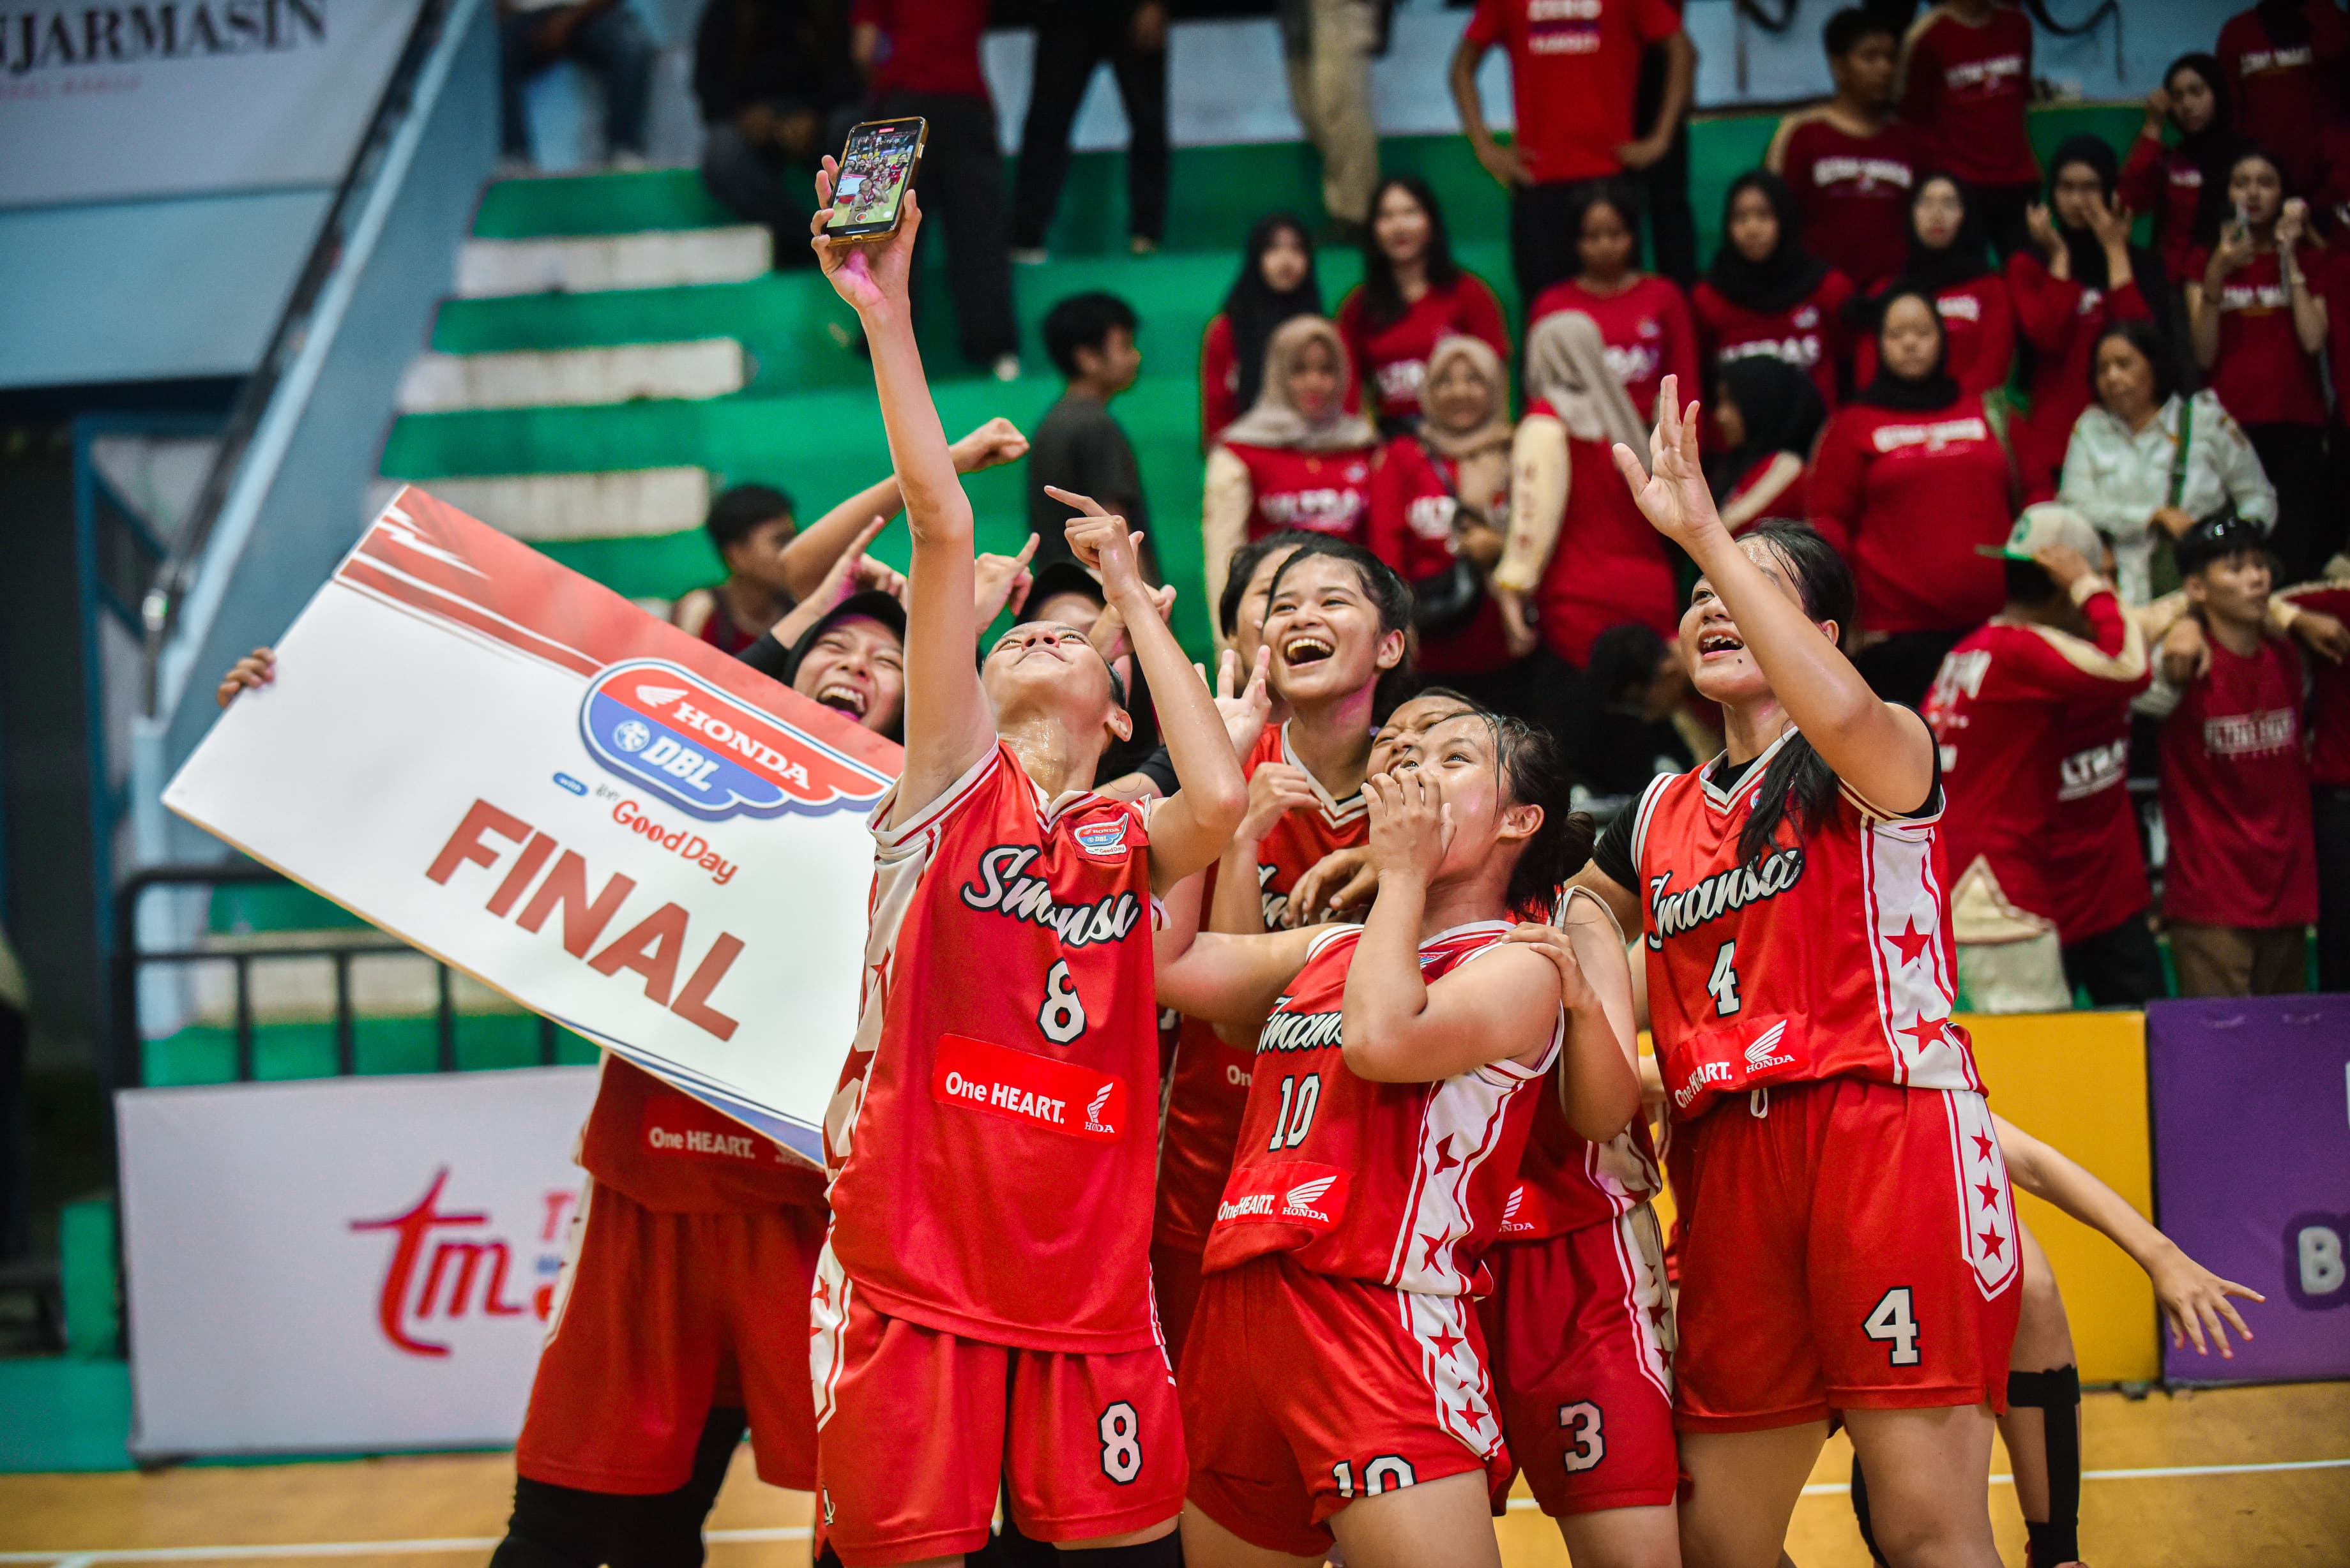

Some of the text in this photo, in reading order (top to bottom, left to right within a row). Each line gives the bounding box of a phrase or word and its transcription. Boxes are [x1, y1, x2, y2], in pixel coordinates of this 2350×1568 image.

[0, 0, 326, 78] JARMASIN
[639, 735, 720, 792] DBL
[672, 701, 810, 790] HONDA
[425, 797, 745, 1043] FINAL
[1037, 957, 1087, 1046] 8
[1707, 939, 1741, 1018] 4
[945, 1071, 1066, 1124] One HEART.
[1674, 1089, 1694, 1108] One
[1745, 1054, 1796, 1074] HONDA
[649, 1126, 756, 1159] One HEART.
[1268, 1073, 1321, 1152] 10
[1217, 1195, 1275, 1221] One HEART.
[1282, 1207, 1330, 1223] HONDA
[1861, 1286, 1921, 1368] 4
[1098, 1399, 1143, 1486] 8
[1559, 1399, 1607, 1475] 3
[1332, 1453, 1418, 1498] 10
